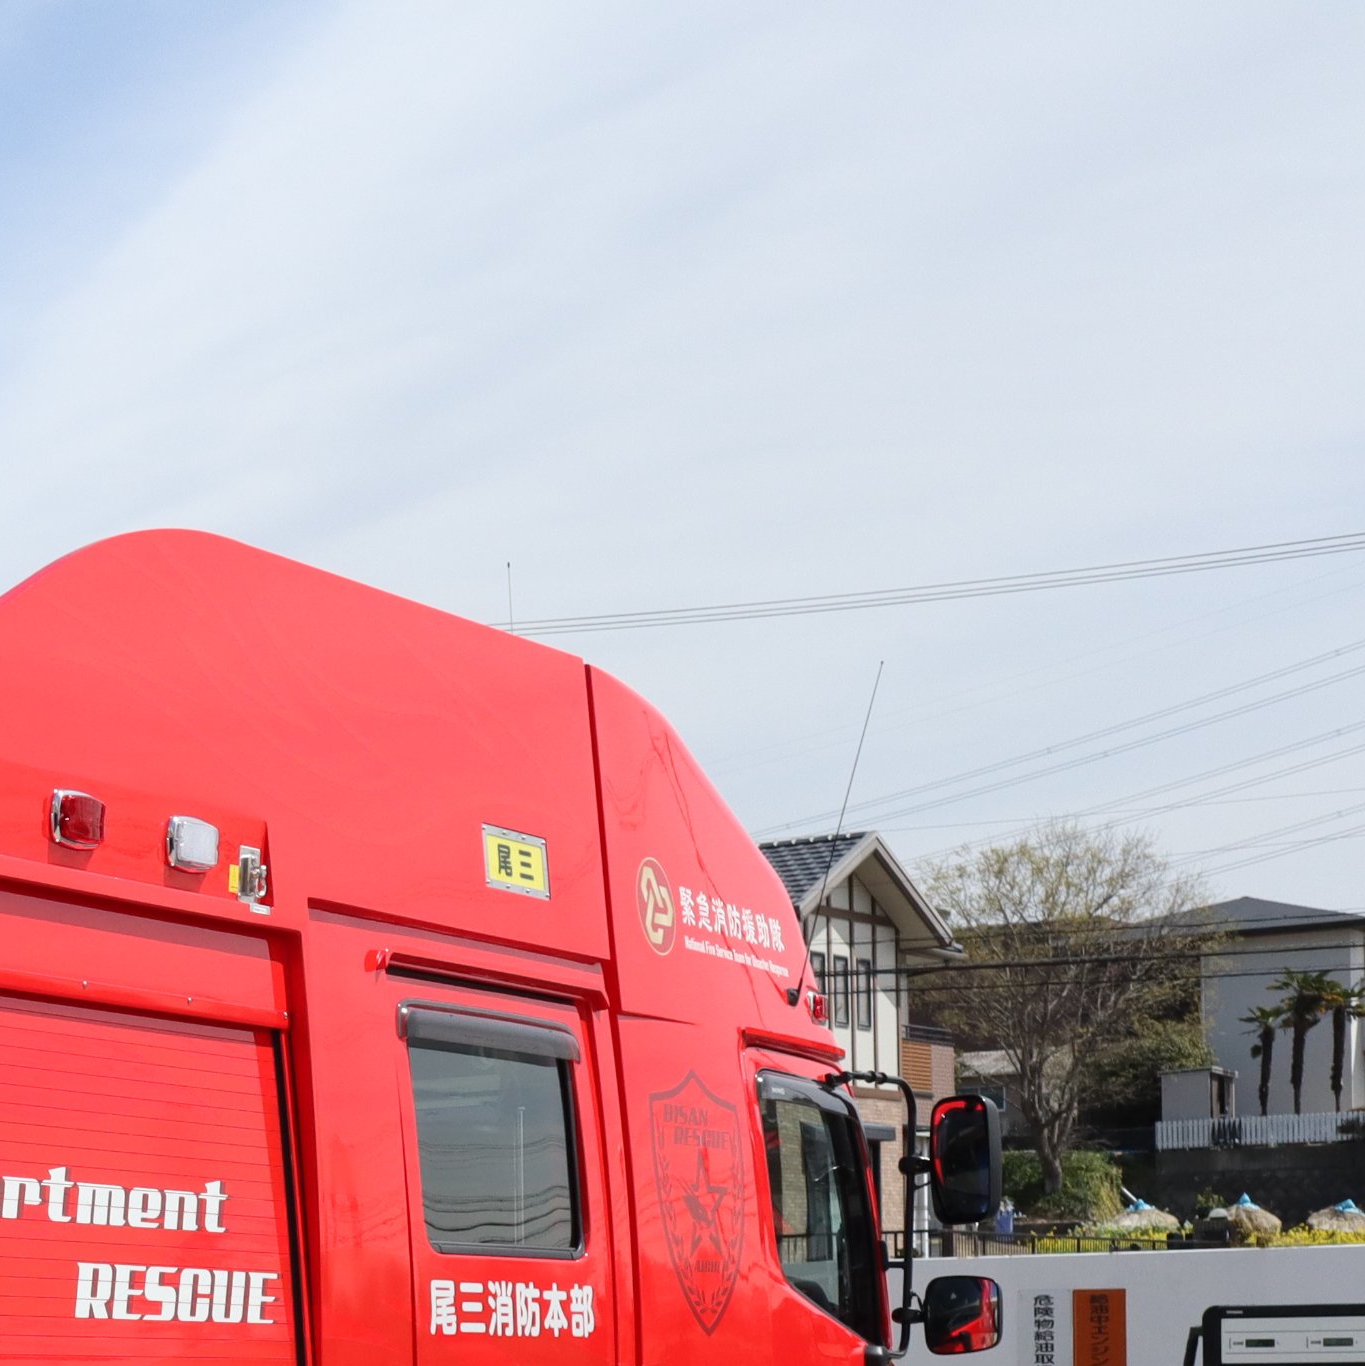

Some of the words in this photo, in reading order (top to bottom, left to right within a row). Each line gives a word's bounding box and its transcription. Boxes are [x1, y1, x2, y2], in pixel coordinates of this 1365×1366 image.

[497, 843, 535, 881] 尾三
[679, 886, 785, 952] 緊急消防援助隊
[663, 1103, 709, 1127] BISAN
[673, 1126, 730, 1149] RESCUE
[74, 1262, 279, 1324] RESCUE
[430, 1279, 595, 1338] 尾三消防本部
